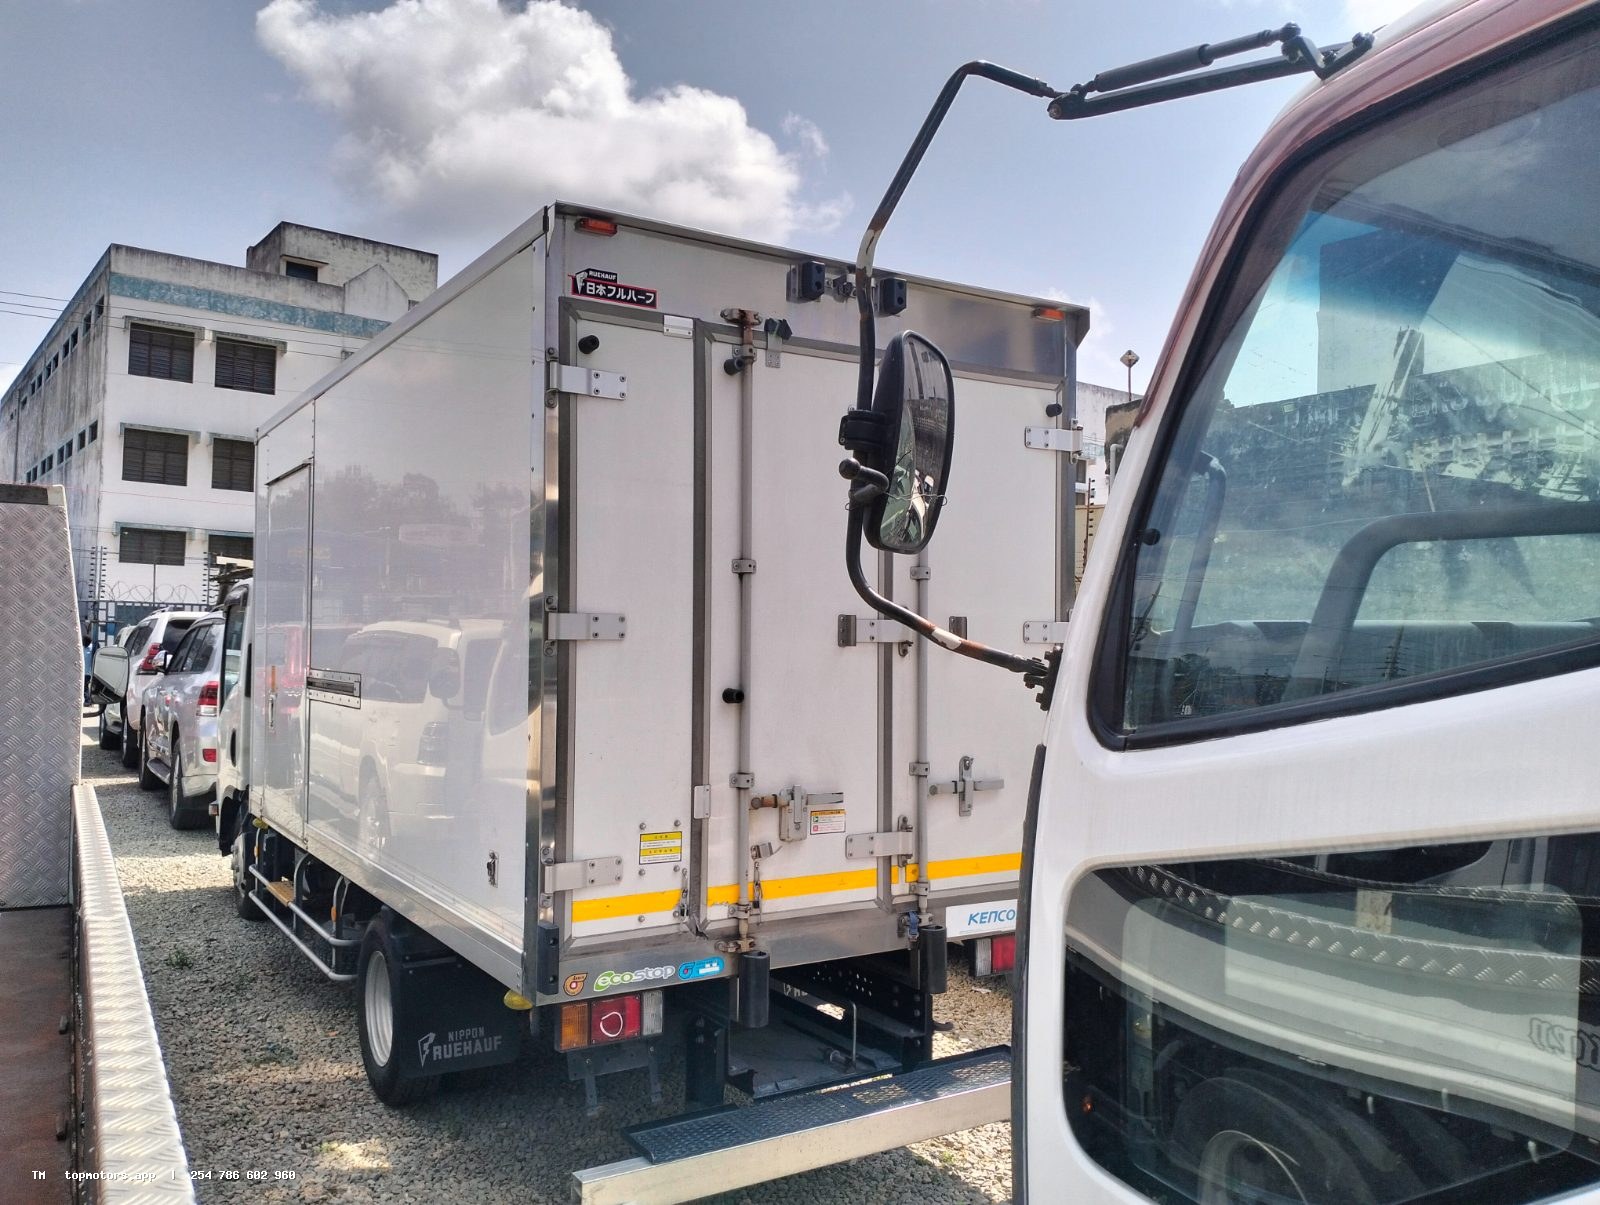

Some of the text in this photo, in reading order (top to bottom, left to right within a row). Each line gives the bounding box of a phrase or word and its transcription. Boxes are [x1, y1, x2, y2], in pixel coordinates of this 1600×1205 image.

[586, 282, 655, 304] 日本フルハーフ
[595, 966, 676, 991] ecostop
[448, 1027, 485, 1041] NIPPON
